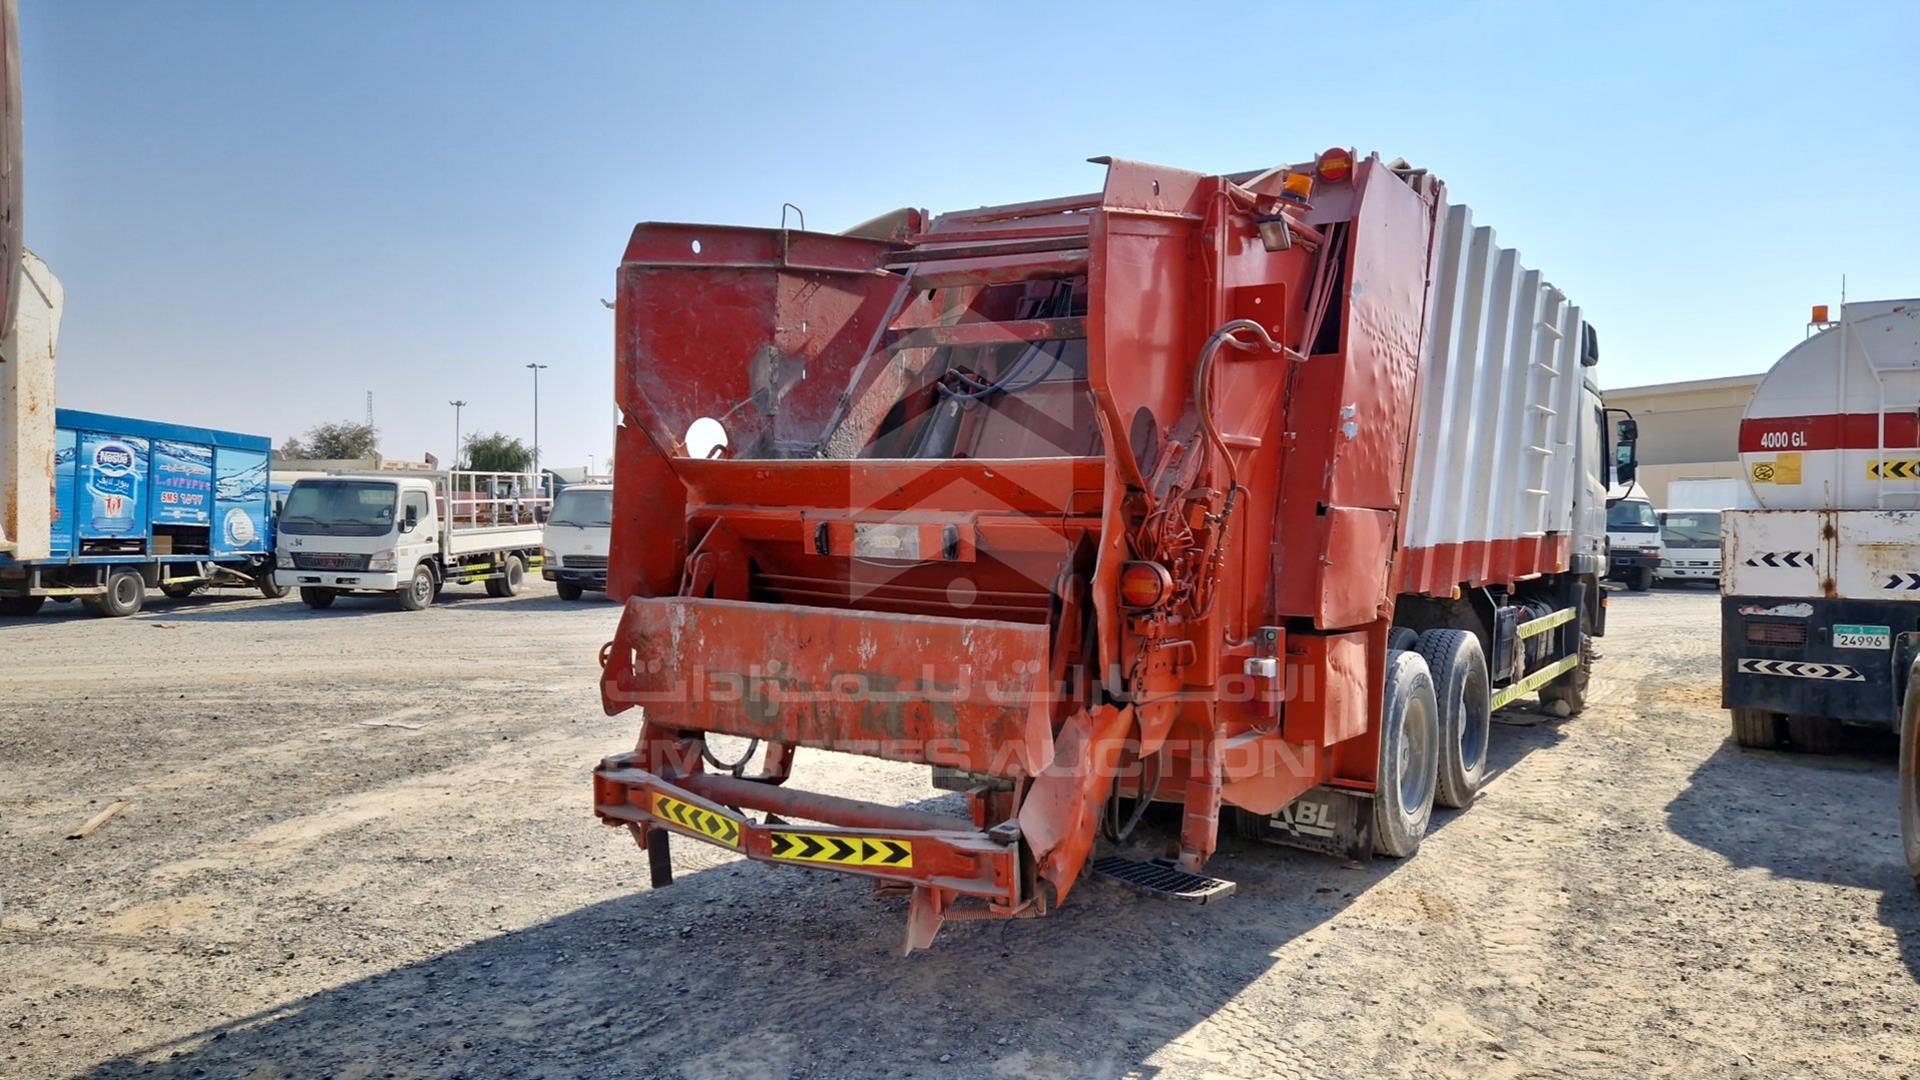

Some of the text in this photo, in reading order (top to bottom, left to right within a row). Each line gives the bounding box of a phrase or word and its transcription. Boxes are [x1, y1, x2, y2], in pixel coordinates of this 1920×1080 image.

[1761, 431, 1788, 448] 4000
[161, 491, 178, 504] SMS
[1841, 635, 1882, 647] 24996
